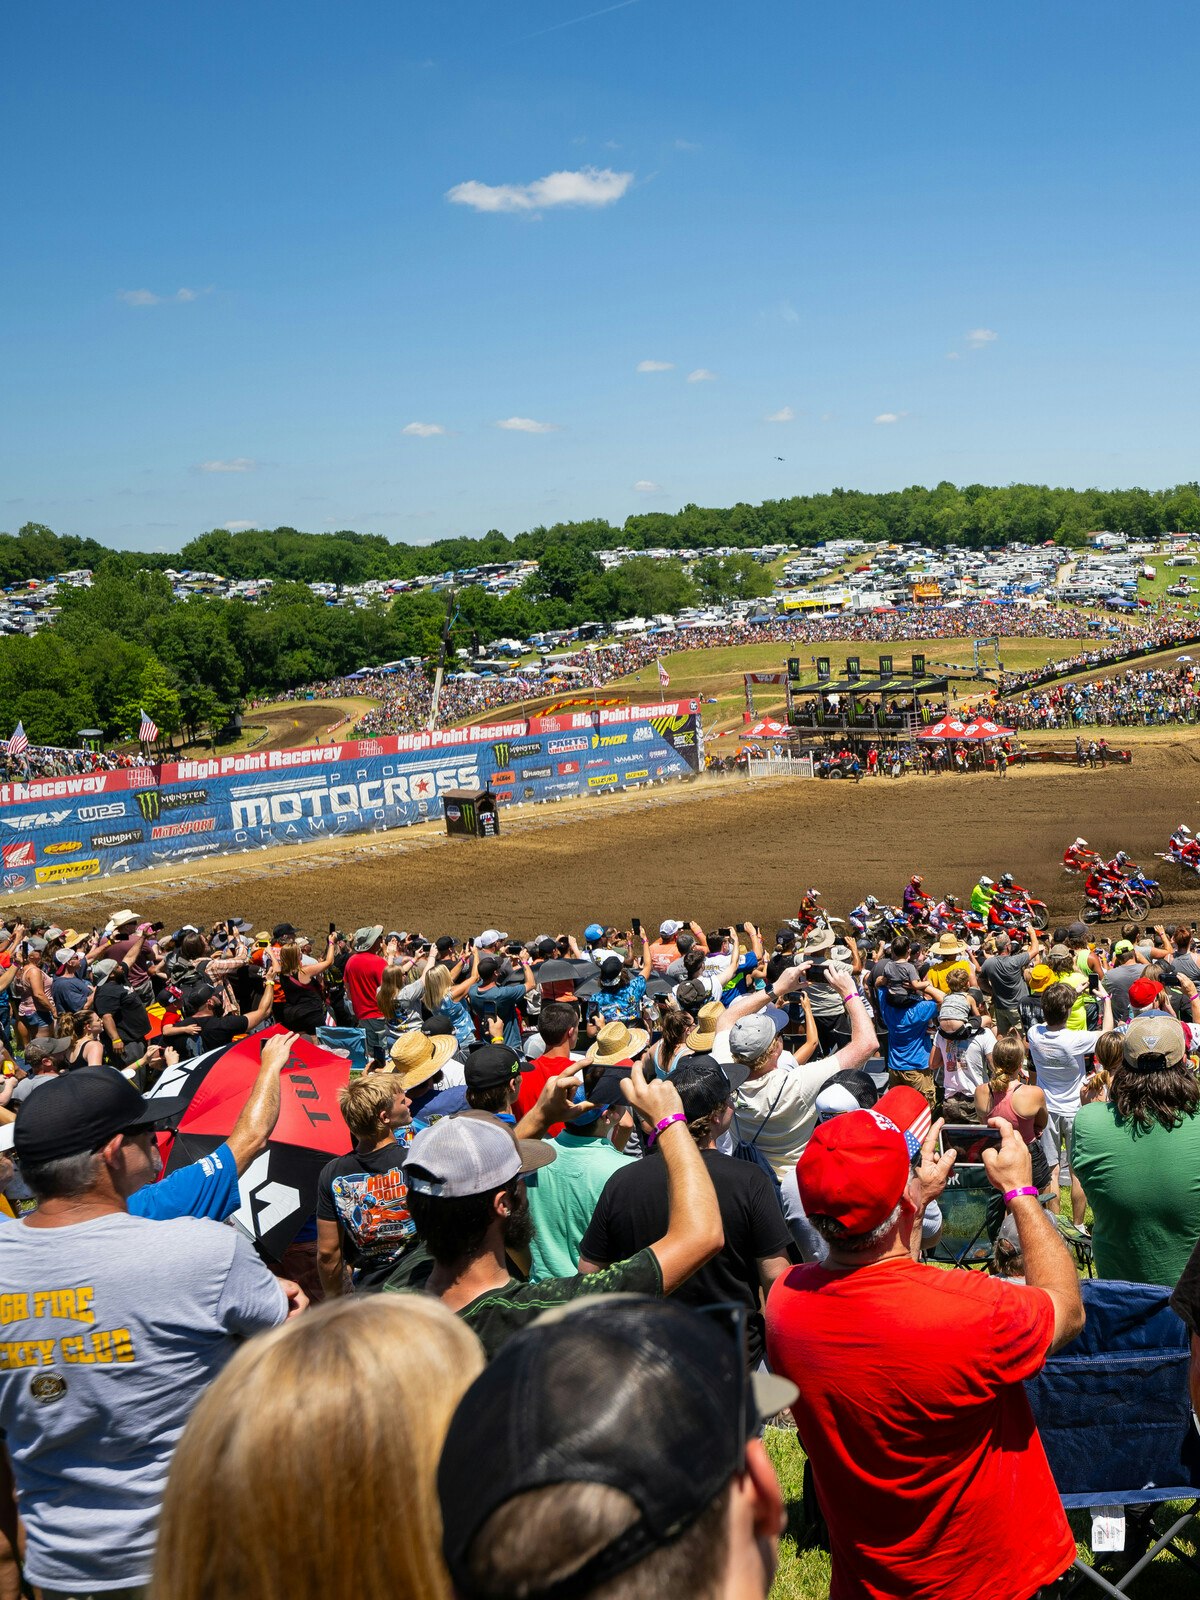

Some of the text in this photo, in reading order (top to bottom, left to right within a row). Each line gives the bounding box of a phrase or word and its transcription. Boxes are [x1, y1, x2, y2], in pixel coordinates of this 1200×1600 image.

[572, 703, 679, 727] High Point Raceway
[398, 722, 528, 750] High Point Raceway
[548, 736, 588, 748] PARTS
[600, 734, 628, 747] THOR
[510, 743, 540, 753] MONSTER
[178, 746, 342, 780] High Point Raceway
[331, 765, 394, 784] PRO
[590, 776, 616, 785] SUZUKI
[14, 775, 107, 801] Raceway
[161, 790, 206, 803] MONSTER
[230, 766, 480, 831] MOTOCROSS
[78, 802, 125, 822] WPS
[92, 831, 132, 845] TRIUMPH
[6, 859, 34, 868] HONDA
[49, 863, 97, 876] DUNLOP
[285, 1050, 331, 1128] TUS
[367, 1169, 402, 1193] High
[372, 1184, 408, 1203] Poin
[33, 1286, 95, 1325] FIRE
[60, 1327, 136, 1364] CLUB
